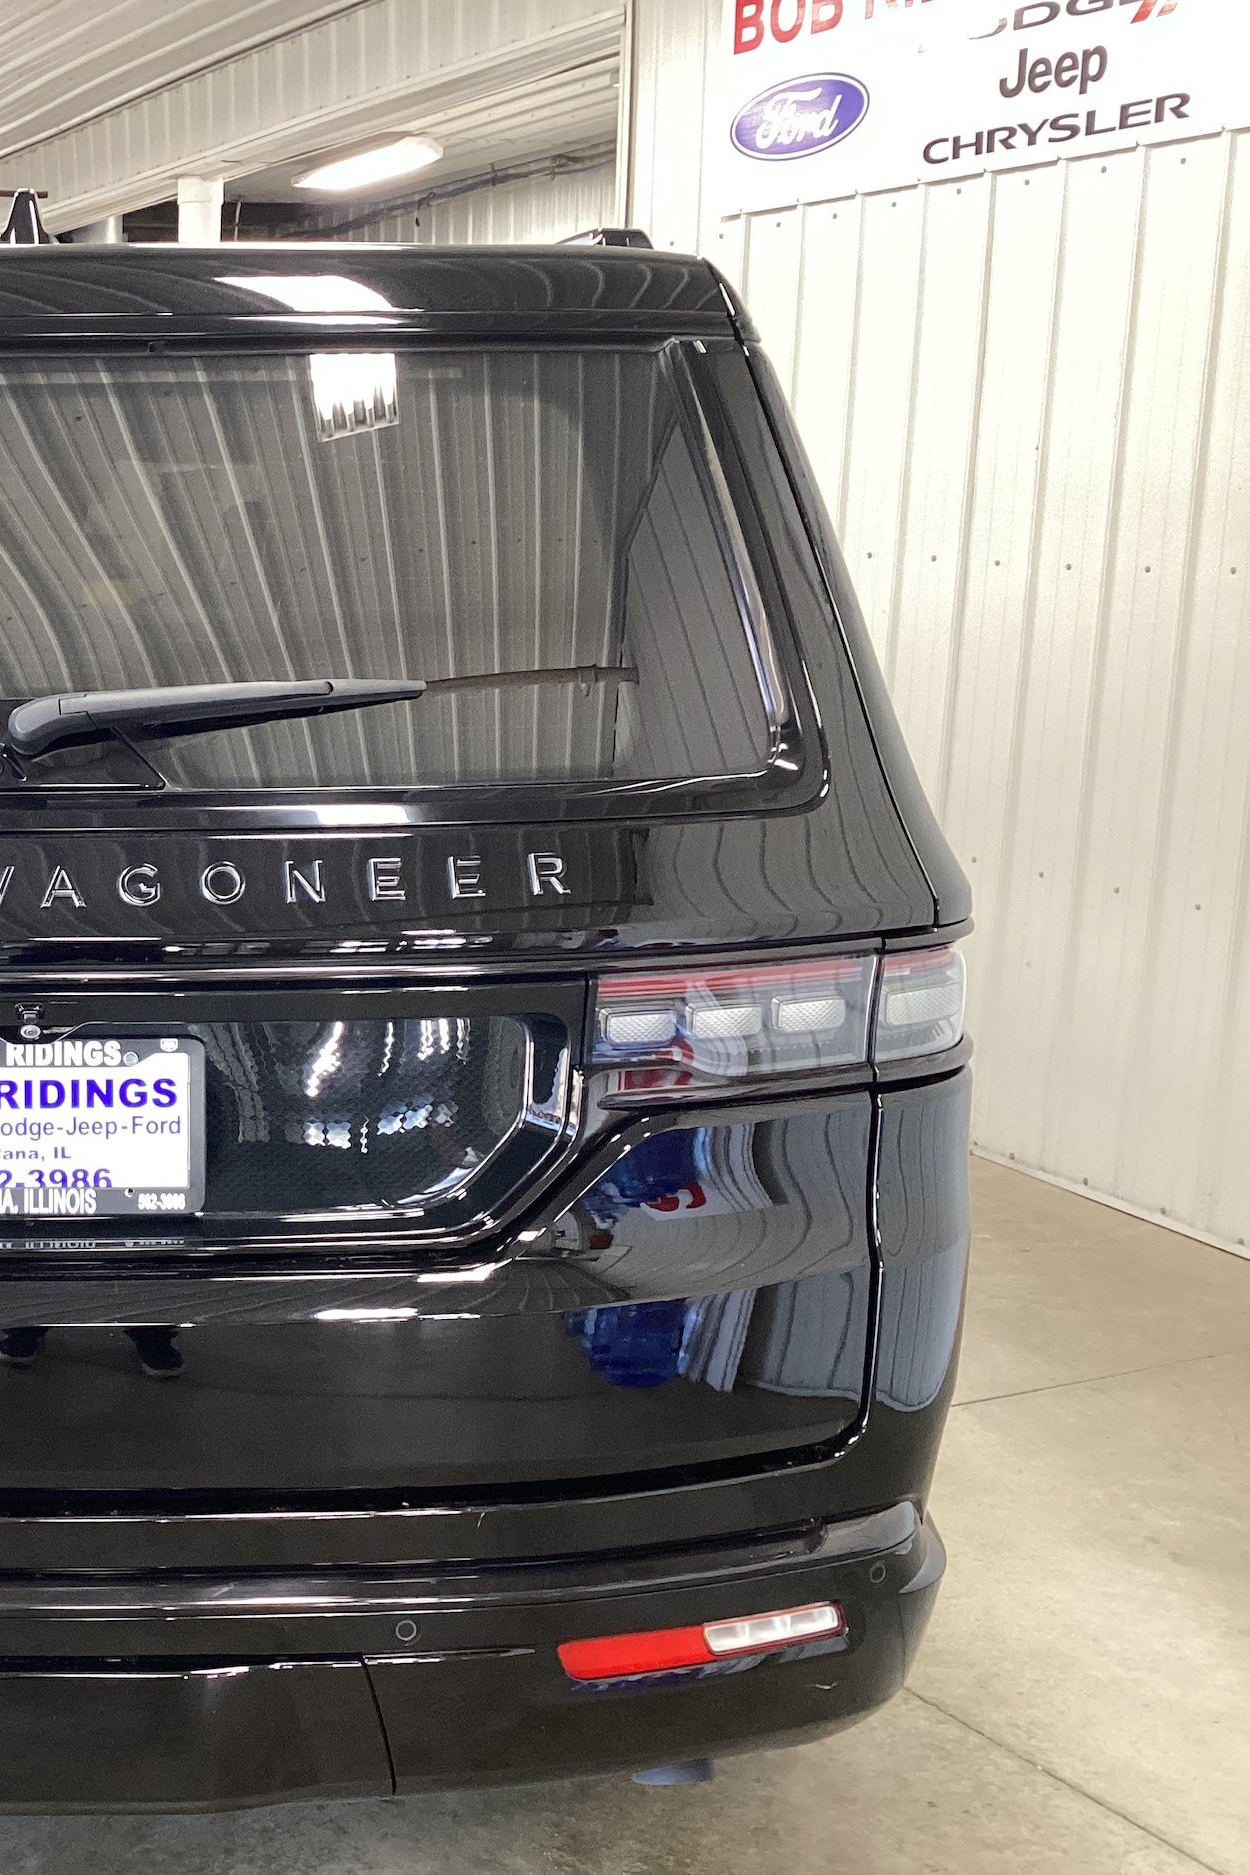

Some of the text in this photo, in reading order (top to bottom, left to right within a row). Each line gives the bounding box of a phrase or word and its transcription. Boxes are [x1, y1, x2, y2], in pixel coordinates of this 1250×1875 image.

[999, 45, 1108, 98] Jeep
[754, 87, 844, 150] Ford
[923, 92, 1191, 165] CHRYSLER
[6, 1040, 122, 1067] RIDINGS
[53, 1146, 72, 1160] IL
[24, 1188, 97, 1214] ILLINOIS
